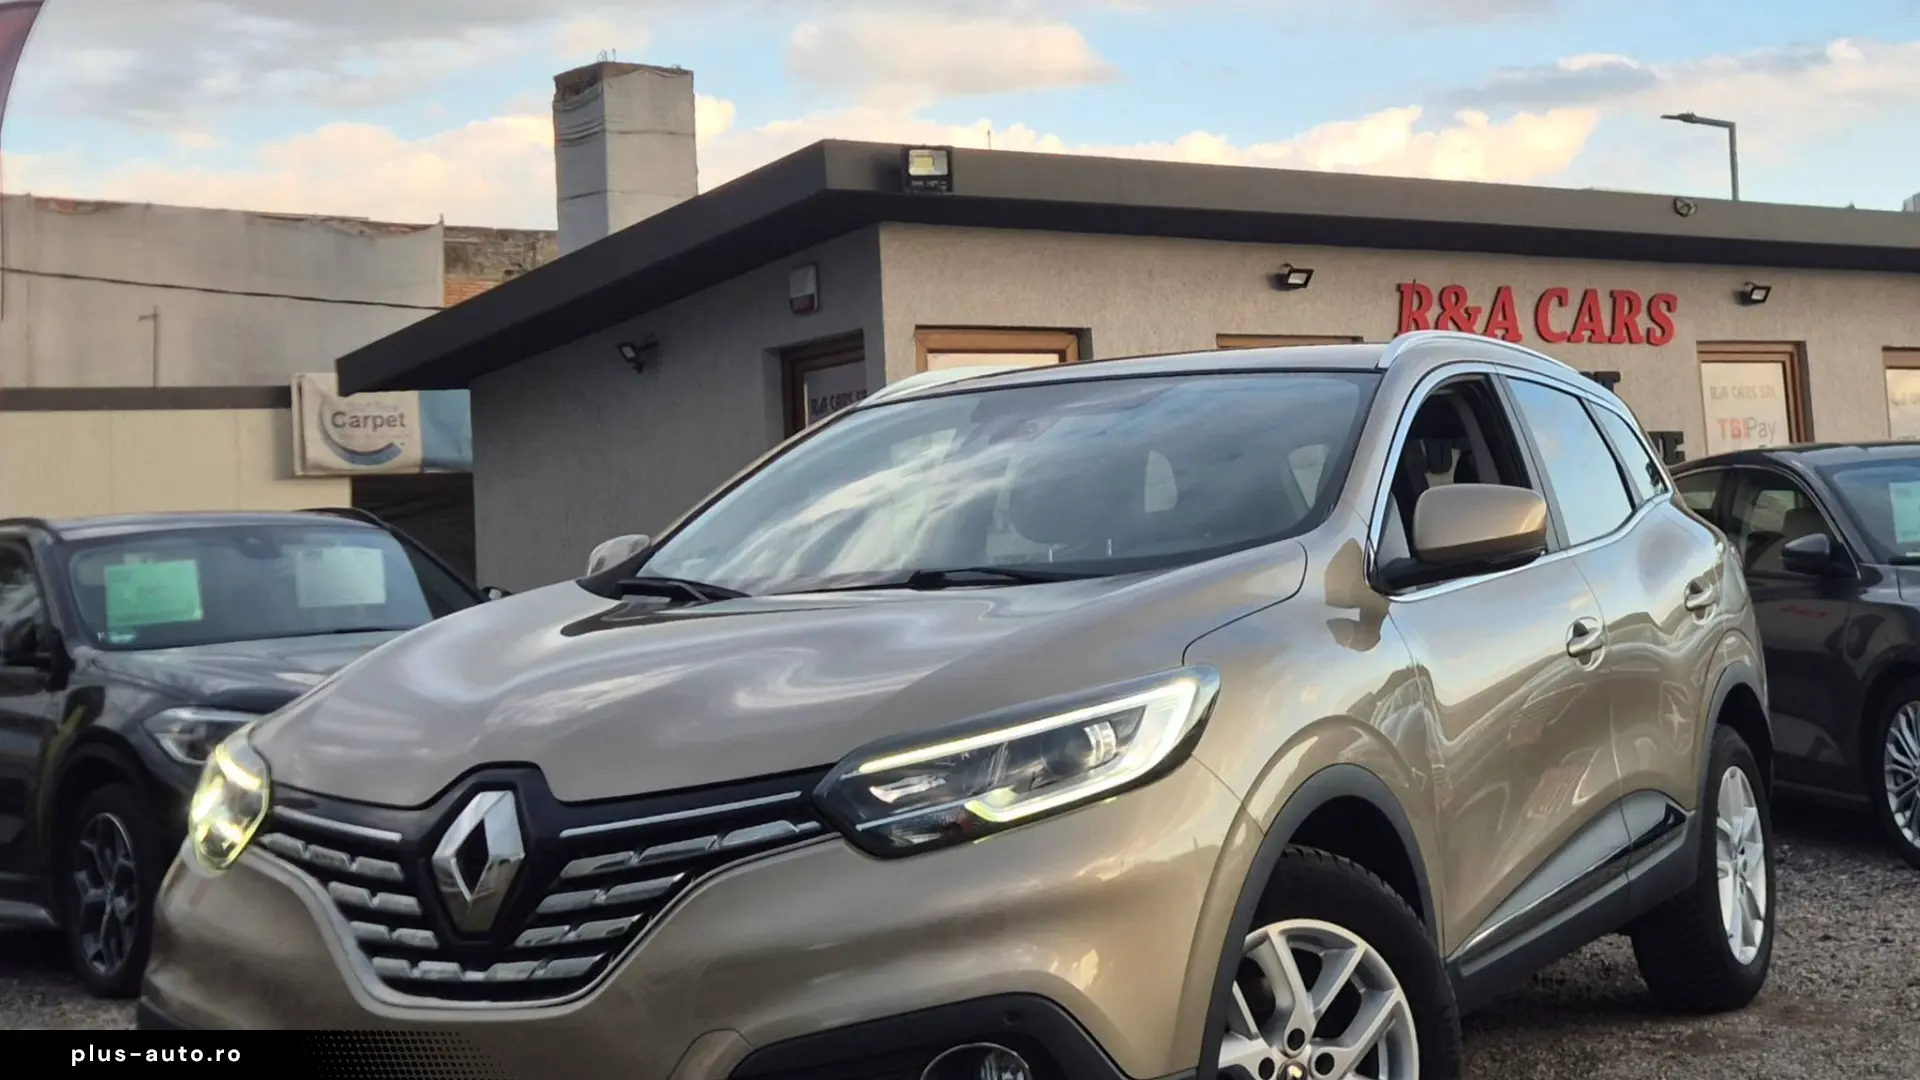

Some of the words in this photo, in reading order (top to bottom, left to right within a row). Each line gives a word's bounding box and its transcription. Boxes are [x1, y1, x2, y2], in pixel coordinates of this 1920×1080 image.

[1394, 282, 1523, 342] R&A
[1535, 287, 1678, 345] CARS
[331, 410, 406, 432] Carpet
